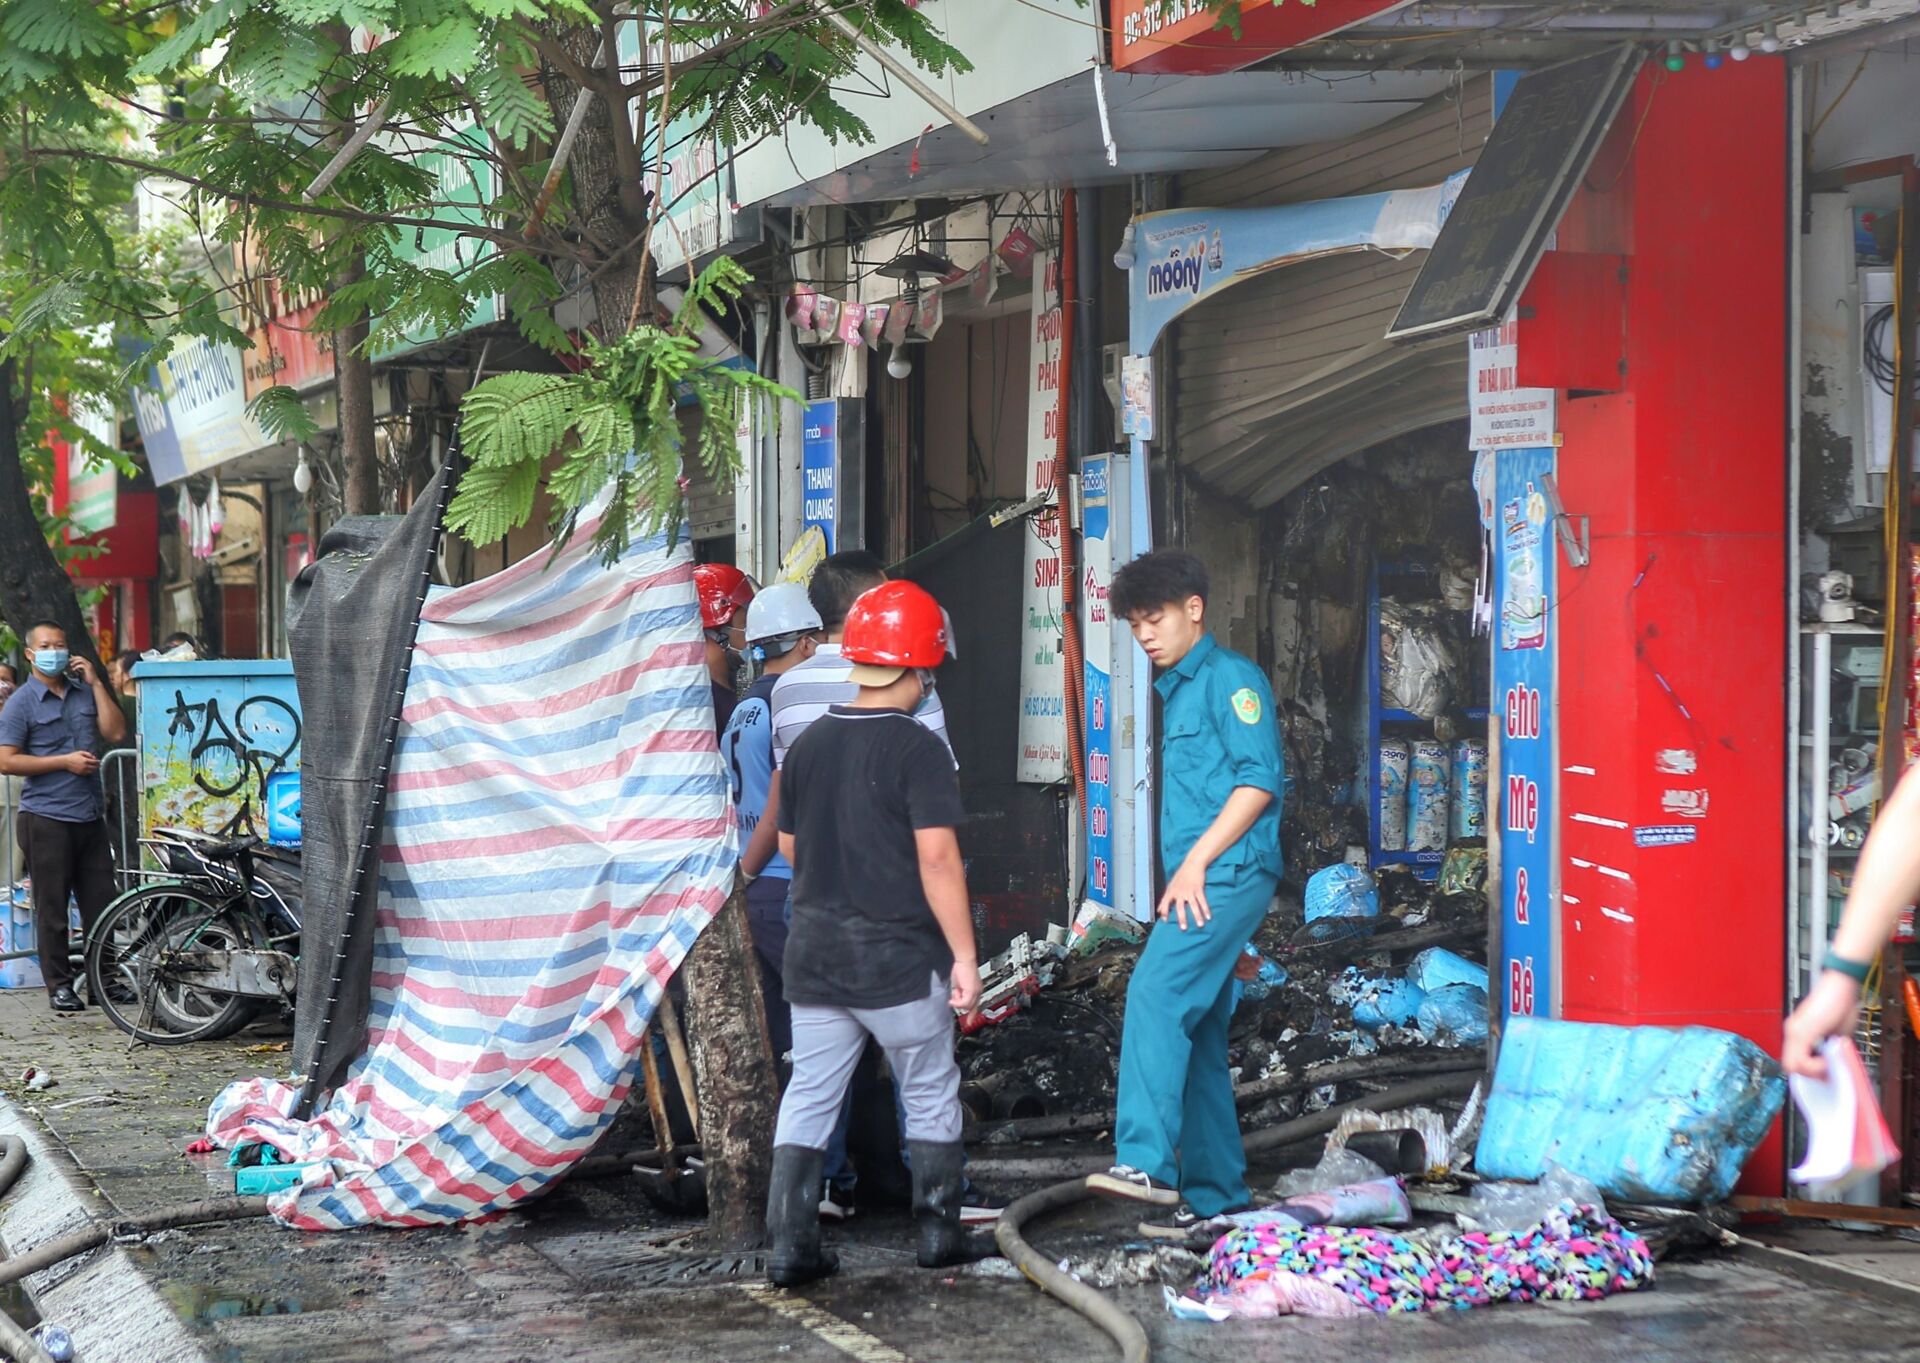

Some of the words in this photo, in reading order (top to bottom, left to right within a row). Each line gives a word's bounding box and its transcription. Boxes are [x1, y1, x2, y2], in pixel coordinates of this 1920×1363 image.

[1148, 255, 1203, 295] moony
[806, 467, 833, 490] THANH
[806, 499, 833, 521] QUANG
[1035, 557, 1060, 588] SINH
[1091, 605, 1106, 623] kids
[1506, 682, 1540, 739] cho
[731, 729, 743, 806] 5
[1089, 747, 1110, 786] dùng
[1092, 804, 1107, 837] cho
[1508, 775, 1538, 844] Mẹ
[1416, 852, 1445, 863] moon
[1094, 857, 1107, 898] Mẹ
[1516, 867, 1529, 925] &
[1510, 956, 1533, 1016] Bé
